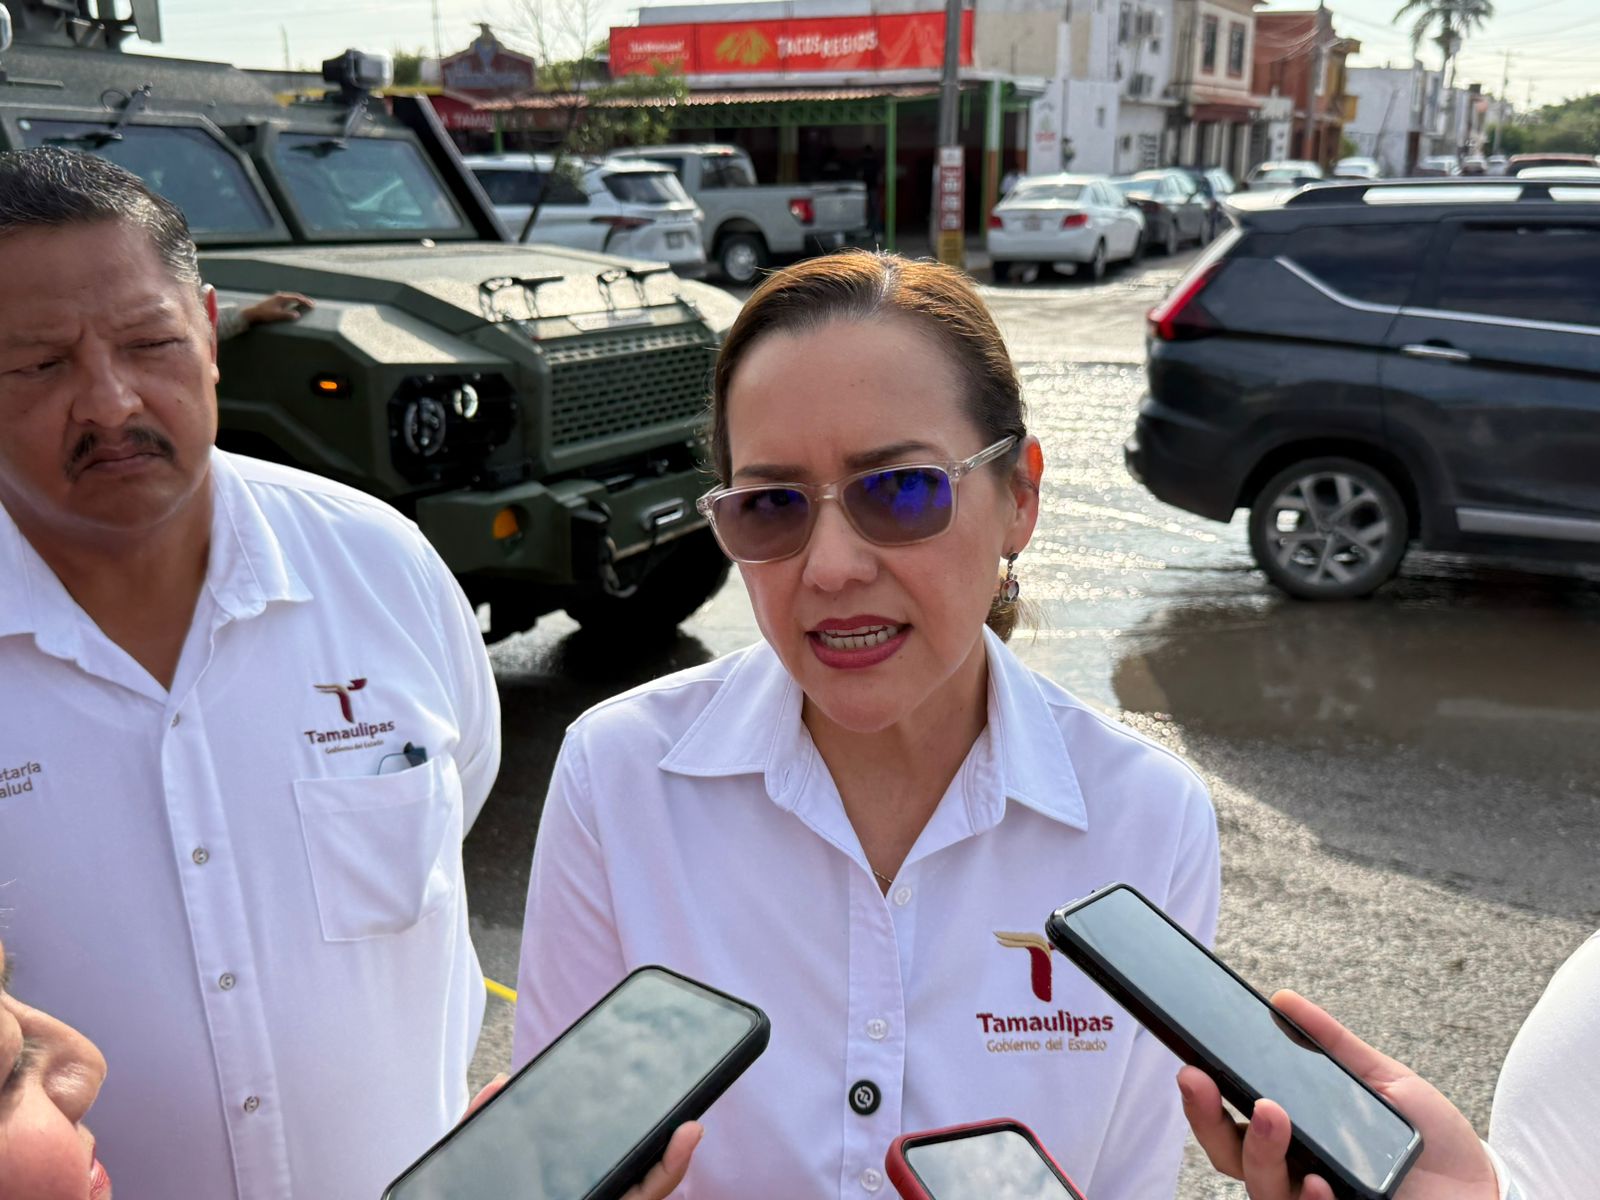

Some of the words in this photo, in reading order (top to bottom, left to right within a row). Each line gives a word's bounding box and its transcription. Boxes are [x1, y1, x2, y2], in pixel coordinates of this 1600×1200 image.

[304, 721, 395, 744] Tamaulipas
[976, 1010, 1114, 1037] Tamaulipas
[987, 1038, 1041, 1053] Gobierno
[1045, 1038, 1063, 1051] del
[1068, 1038, 1107, 1051] Estado
